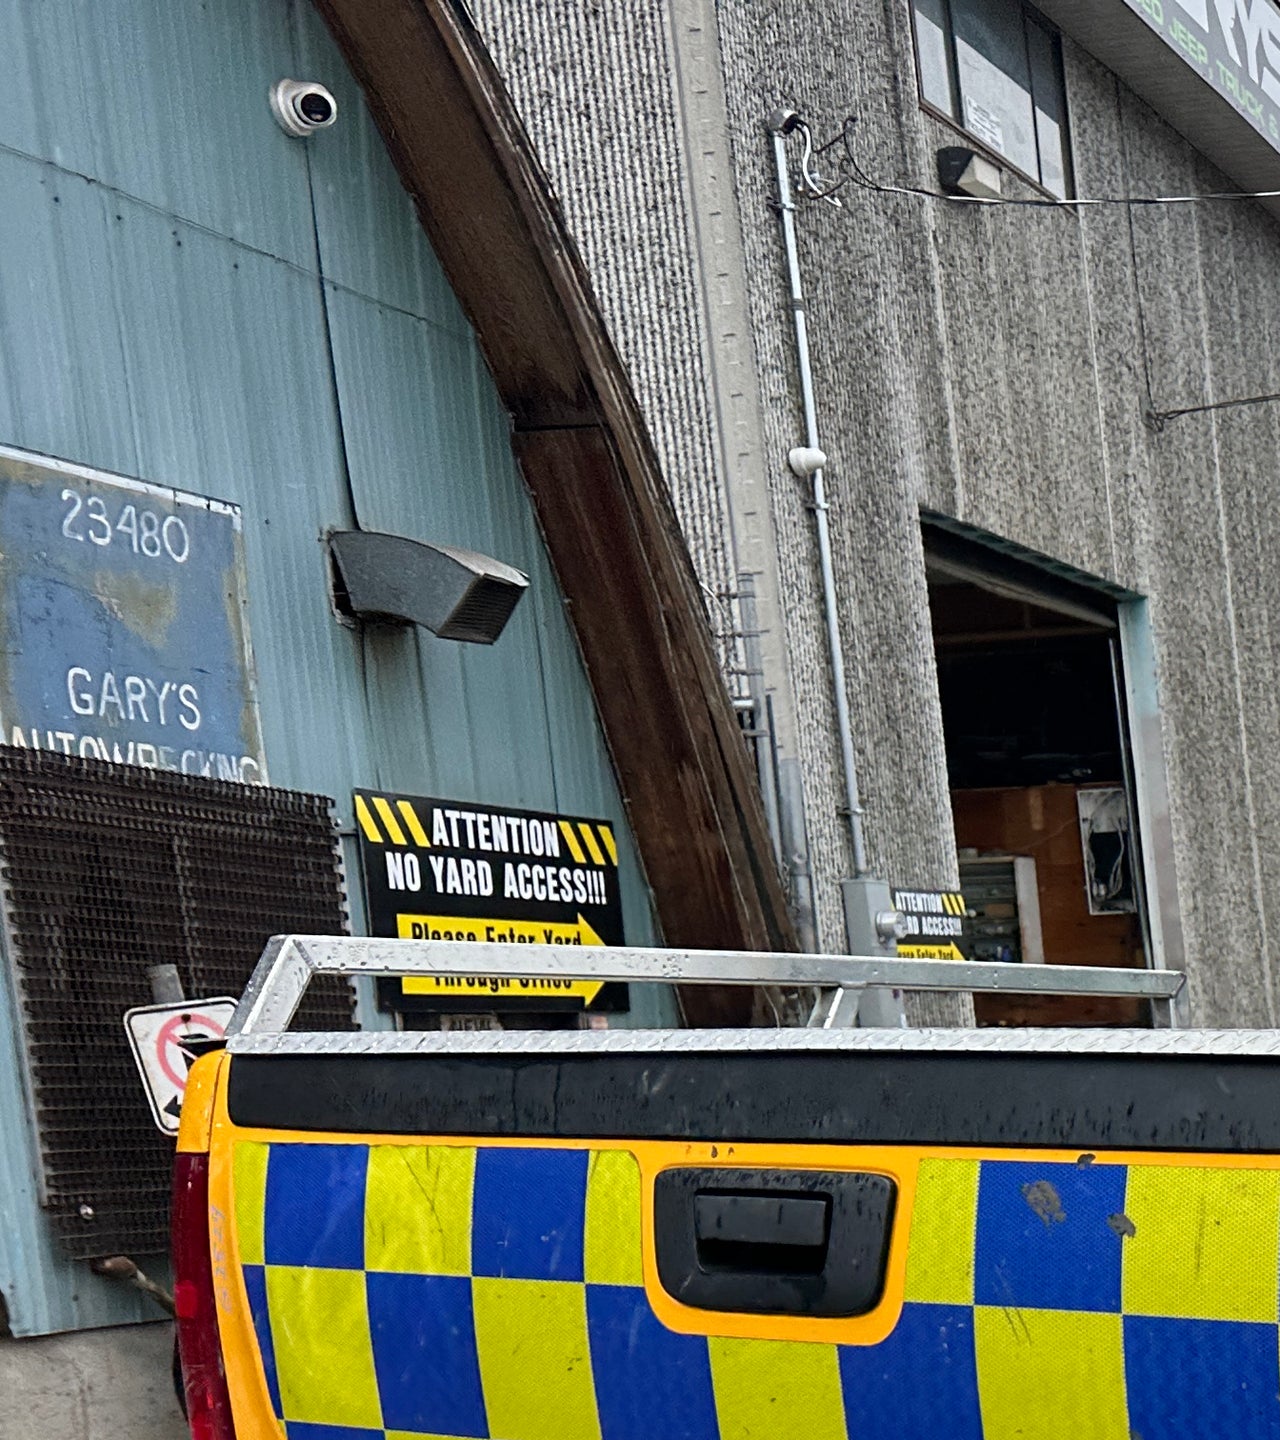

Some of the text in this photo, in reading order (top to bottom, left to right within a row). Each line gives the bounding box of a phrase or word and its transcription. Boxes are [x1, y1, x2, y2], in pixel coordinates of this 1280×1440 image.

[61, 489, 190, 563] 23480
[67, 667, 201, 730] GARY'S
[432, 807, 560, 858] ATTENTION
[385, 851, 607, 905] NO YARD ACCESS!!!
[895, 891, 943, 913] ATTENTION
